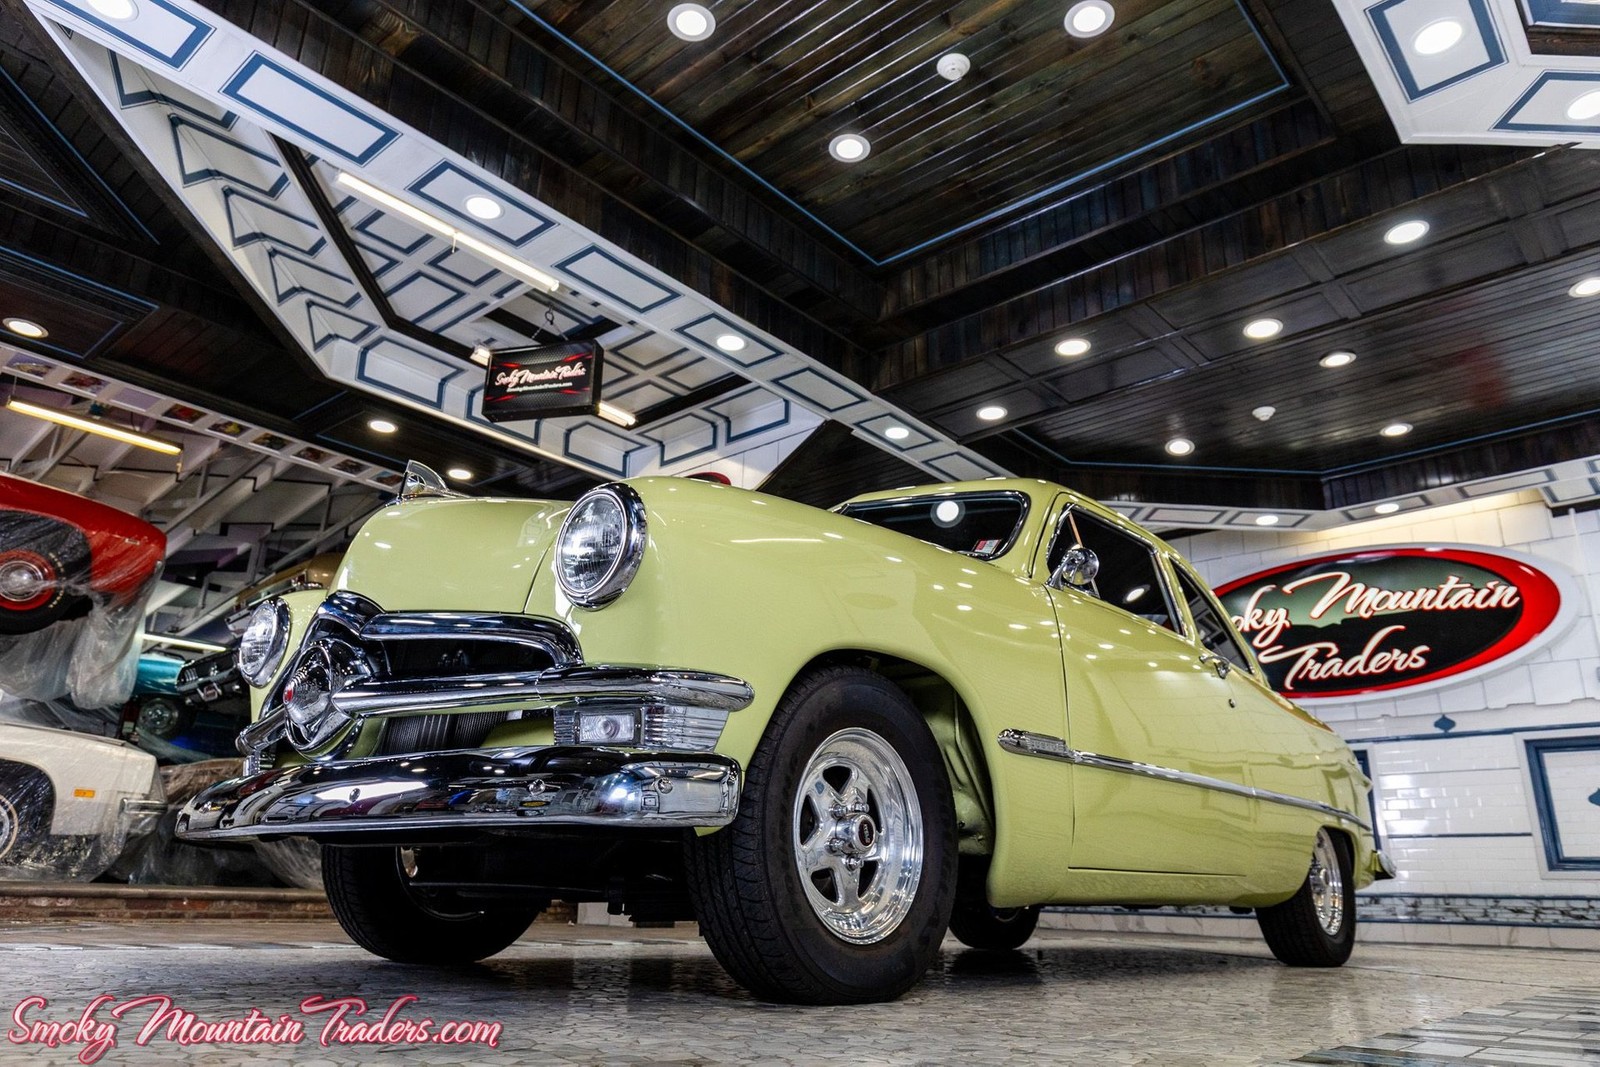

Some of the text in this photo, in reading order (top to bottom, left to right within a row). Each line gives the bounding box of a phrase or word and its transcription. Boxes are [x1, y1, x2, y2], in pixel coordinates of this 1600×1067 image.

[1230, 571, 1520, 649] oky Mountain
[1258, 625, 1431, 690] Traders
